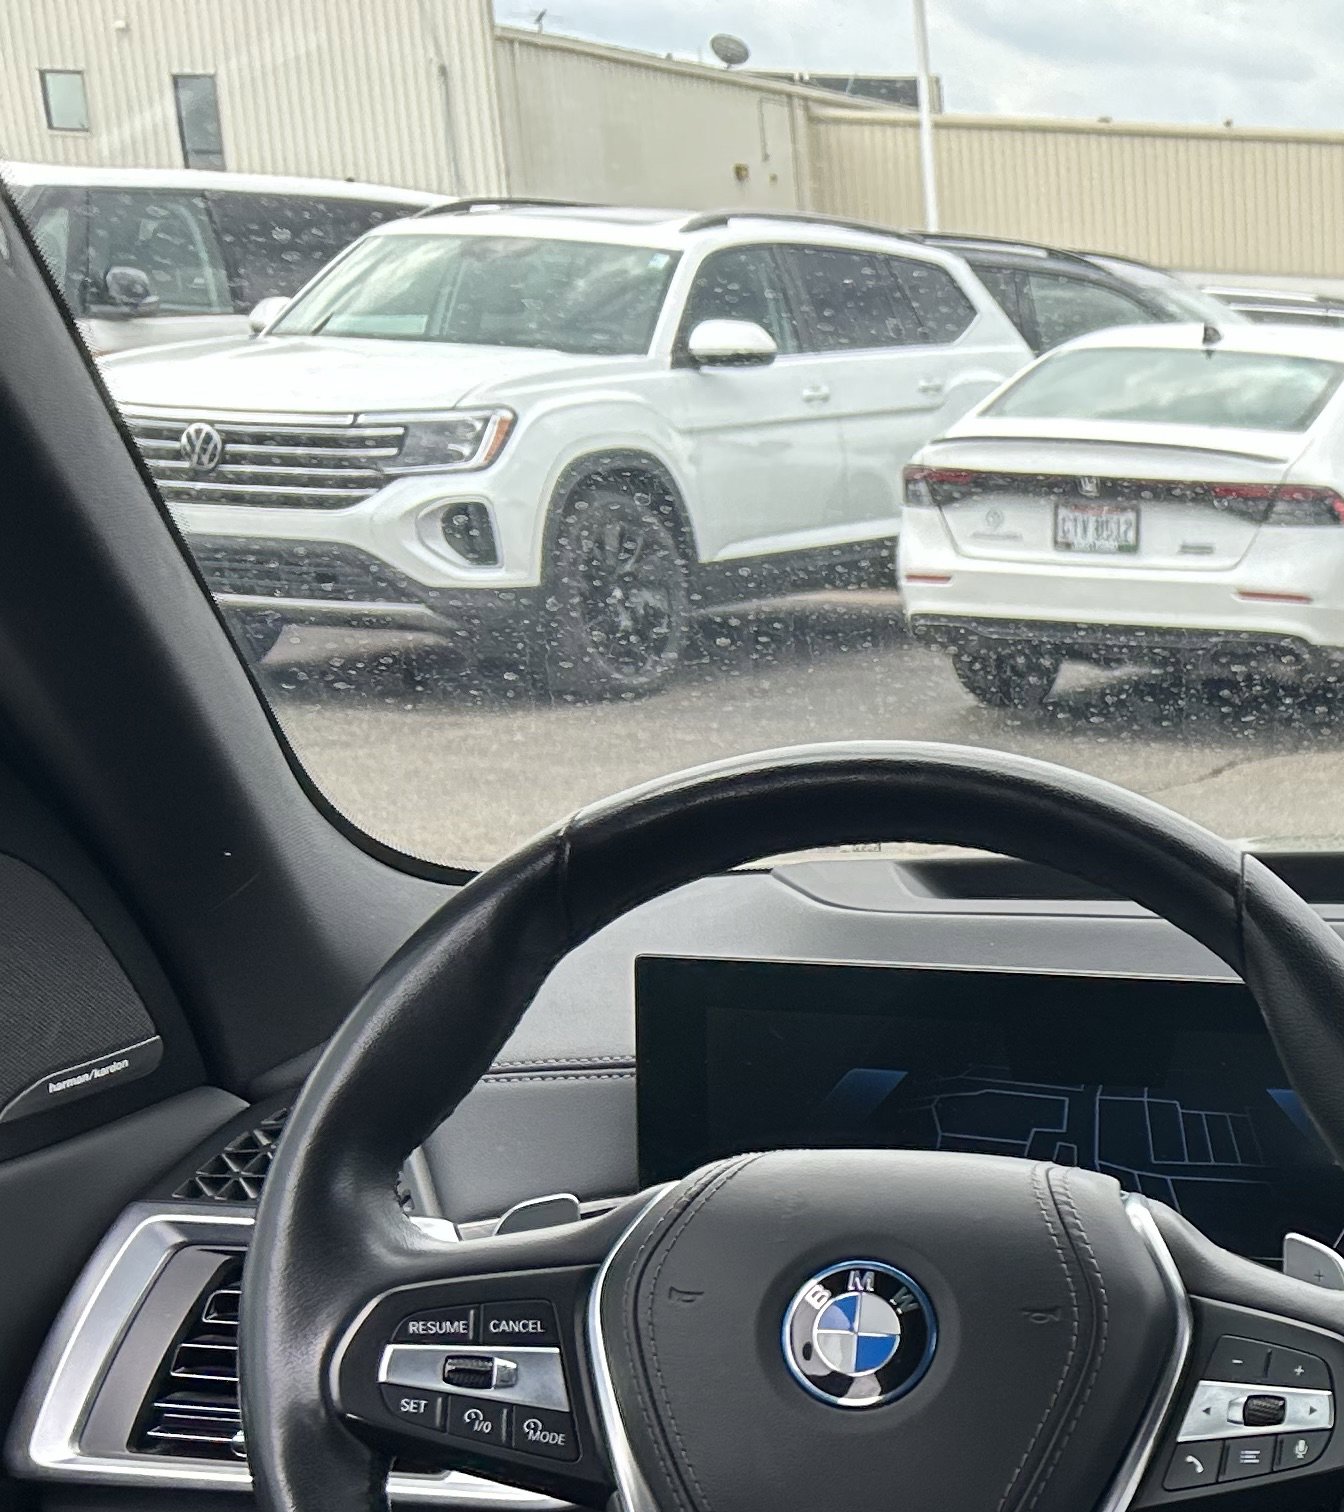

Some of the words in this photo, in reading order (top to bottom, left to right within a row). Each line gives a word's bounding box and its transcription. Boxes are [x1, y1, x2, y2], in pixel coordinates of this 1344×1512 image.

[48, 1058, 129, 1094] harman/kardon
[803, 1270, 921, 1315] BMW
[408, 1320, 468, 1334] RESUME
[490, 1320, 545, 1333] CANCEL
[400, 1398, 428, 1413] SET
[527, 1430, 566, 1446] MODE
